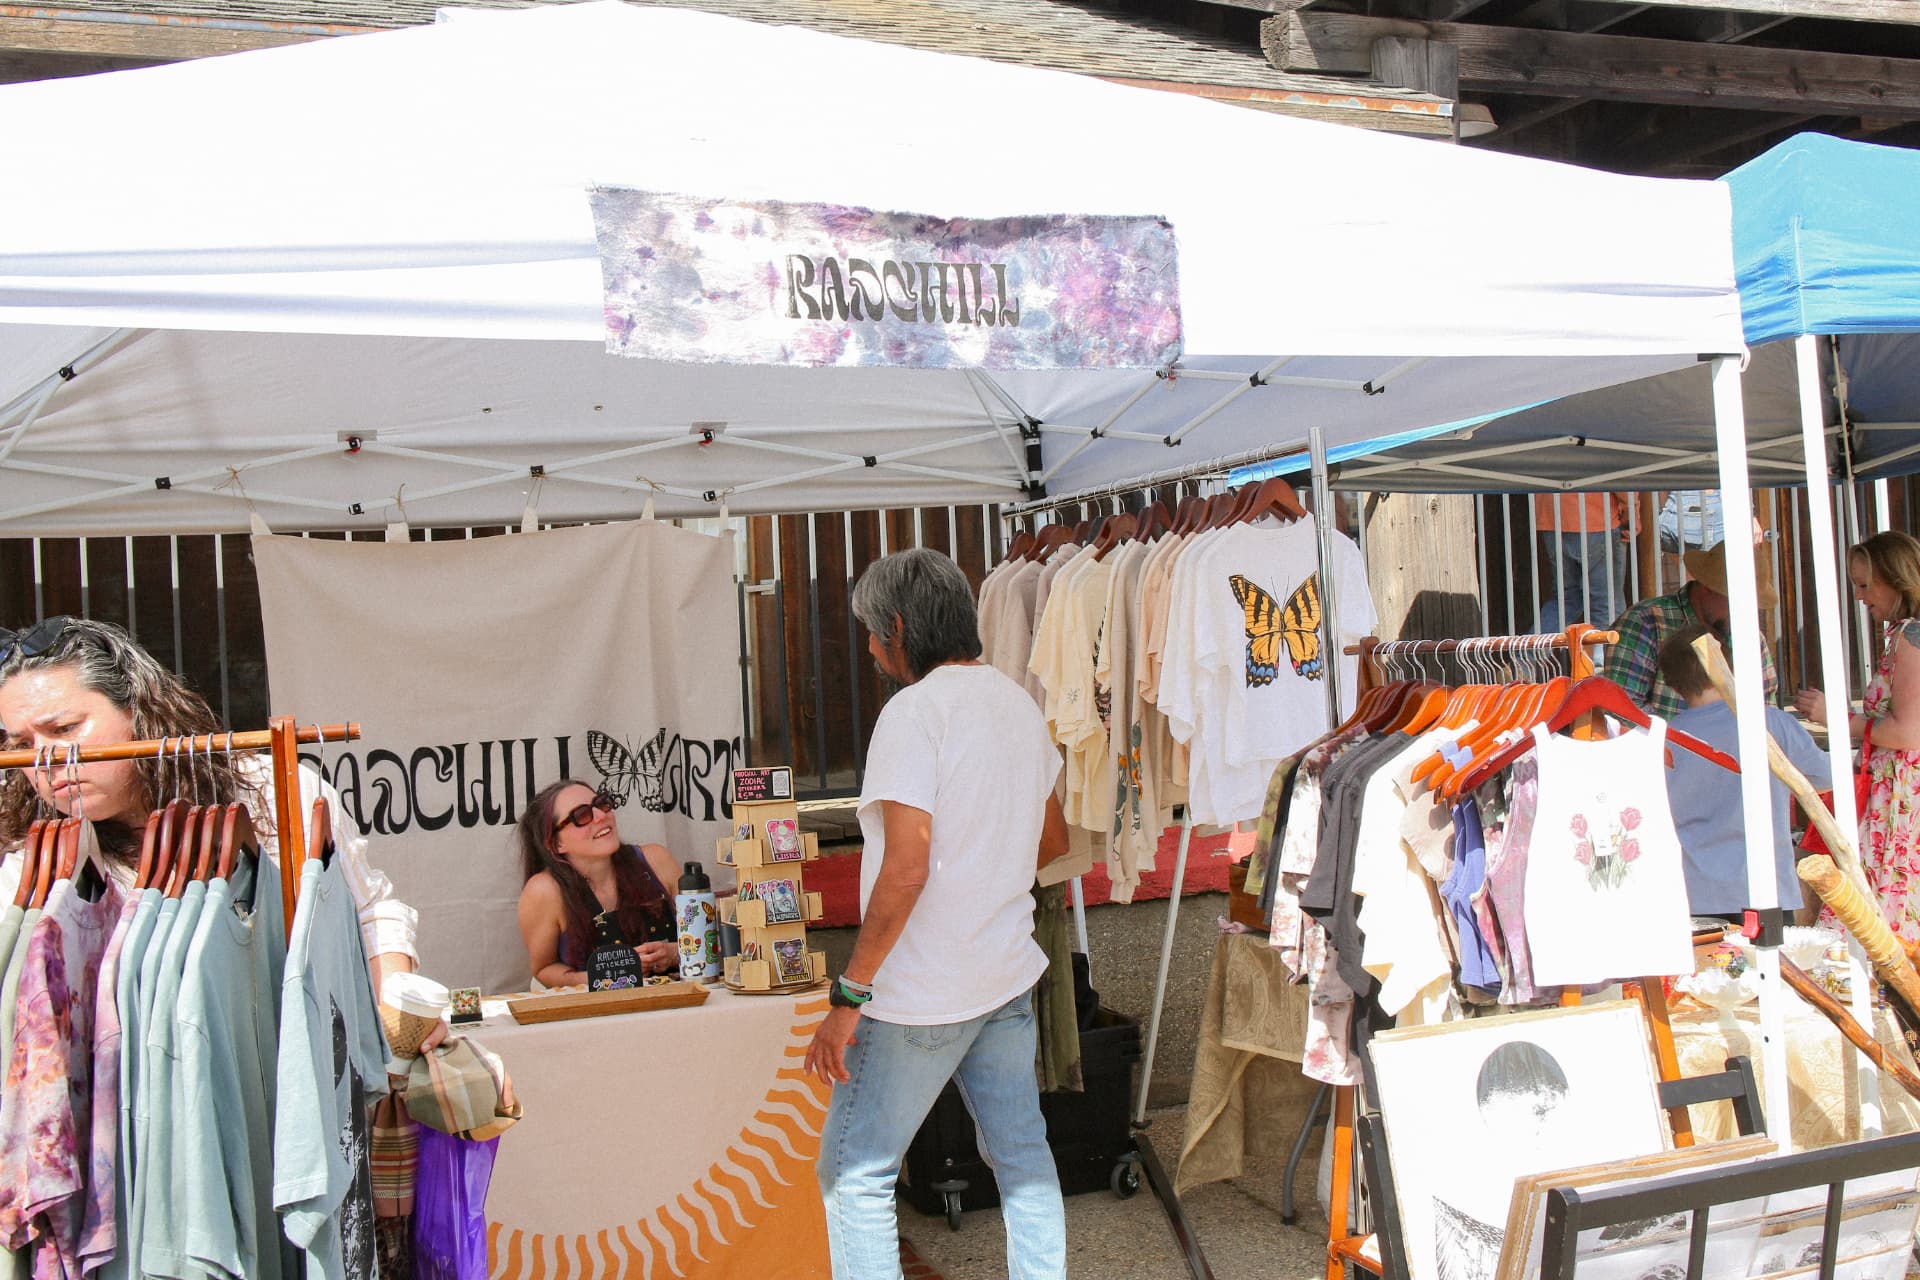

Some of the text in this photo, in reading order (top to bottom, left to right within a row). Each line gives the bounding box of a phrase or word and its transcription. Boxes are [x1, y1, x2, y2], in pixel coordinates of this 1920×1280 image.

[785, 254, 1020, 327] RADCHILL
[298, 735, 572, 836] ADCHI
[595, 957, 636, 971] STICKERS
[597, 949, 634, 963] RADCHILL
